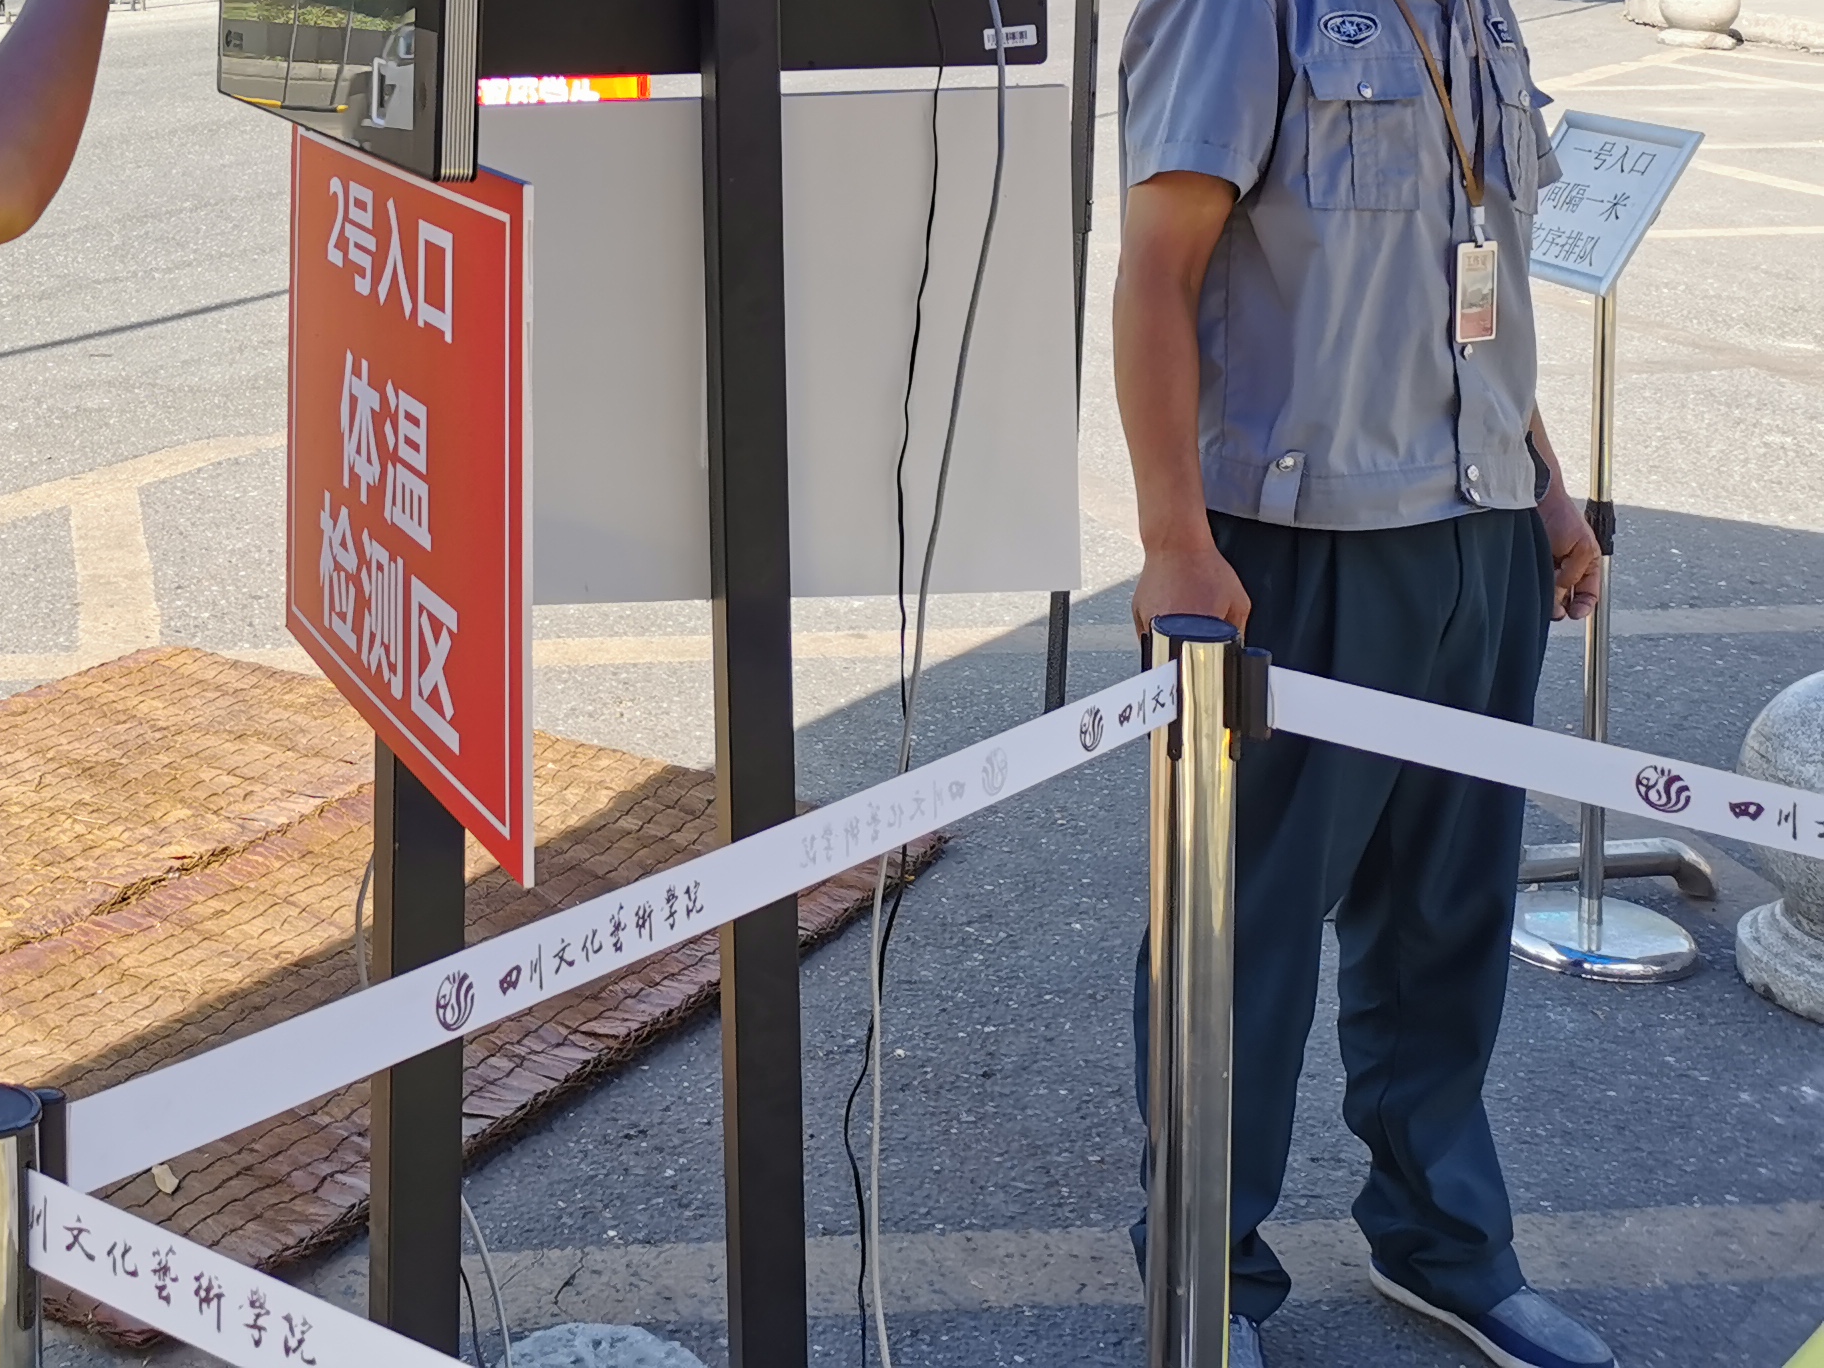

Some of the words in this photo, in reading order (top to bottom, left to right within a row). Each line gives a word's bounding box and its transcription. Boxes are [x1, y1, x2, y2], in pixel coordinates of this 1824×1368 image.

[1540, 180, 1631, 223] 间隔一米
[1573, 140, 1657, 176] 一号入口
[326, 174, 455, 345] 2号入口
[339, 348, 433, 552] 体温
[318, 488, 461, 756] 检测区
[1728, 800, 1824, 841] 四川
